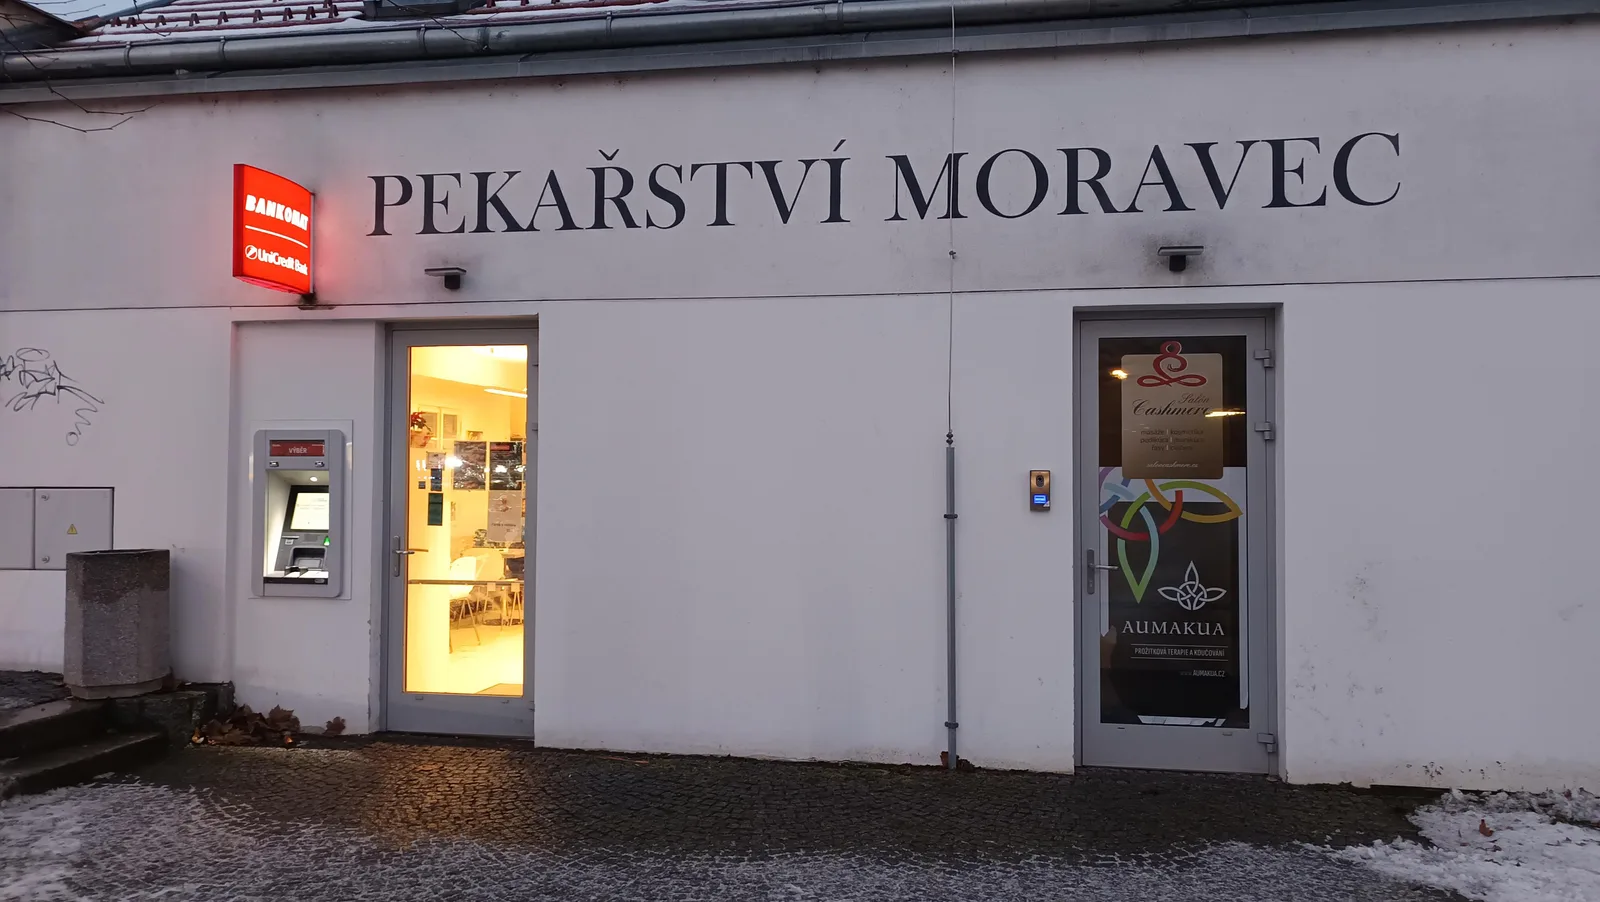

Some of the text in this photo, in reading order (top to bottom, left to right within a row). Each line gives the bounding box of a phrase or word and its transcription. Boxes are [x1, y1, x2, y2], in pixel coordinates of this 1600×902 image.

[366, 132, 1401, 237] PEKAŘSTVÍ MORAVEC
[257, 248, 308, 276] UniCredit Bank
[1121, 620, 1225, 636] AUMAKUA
[1167, 648, 1189, 656] TERAPIE
